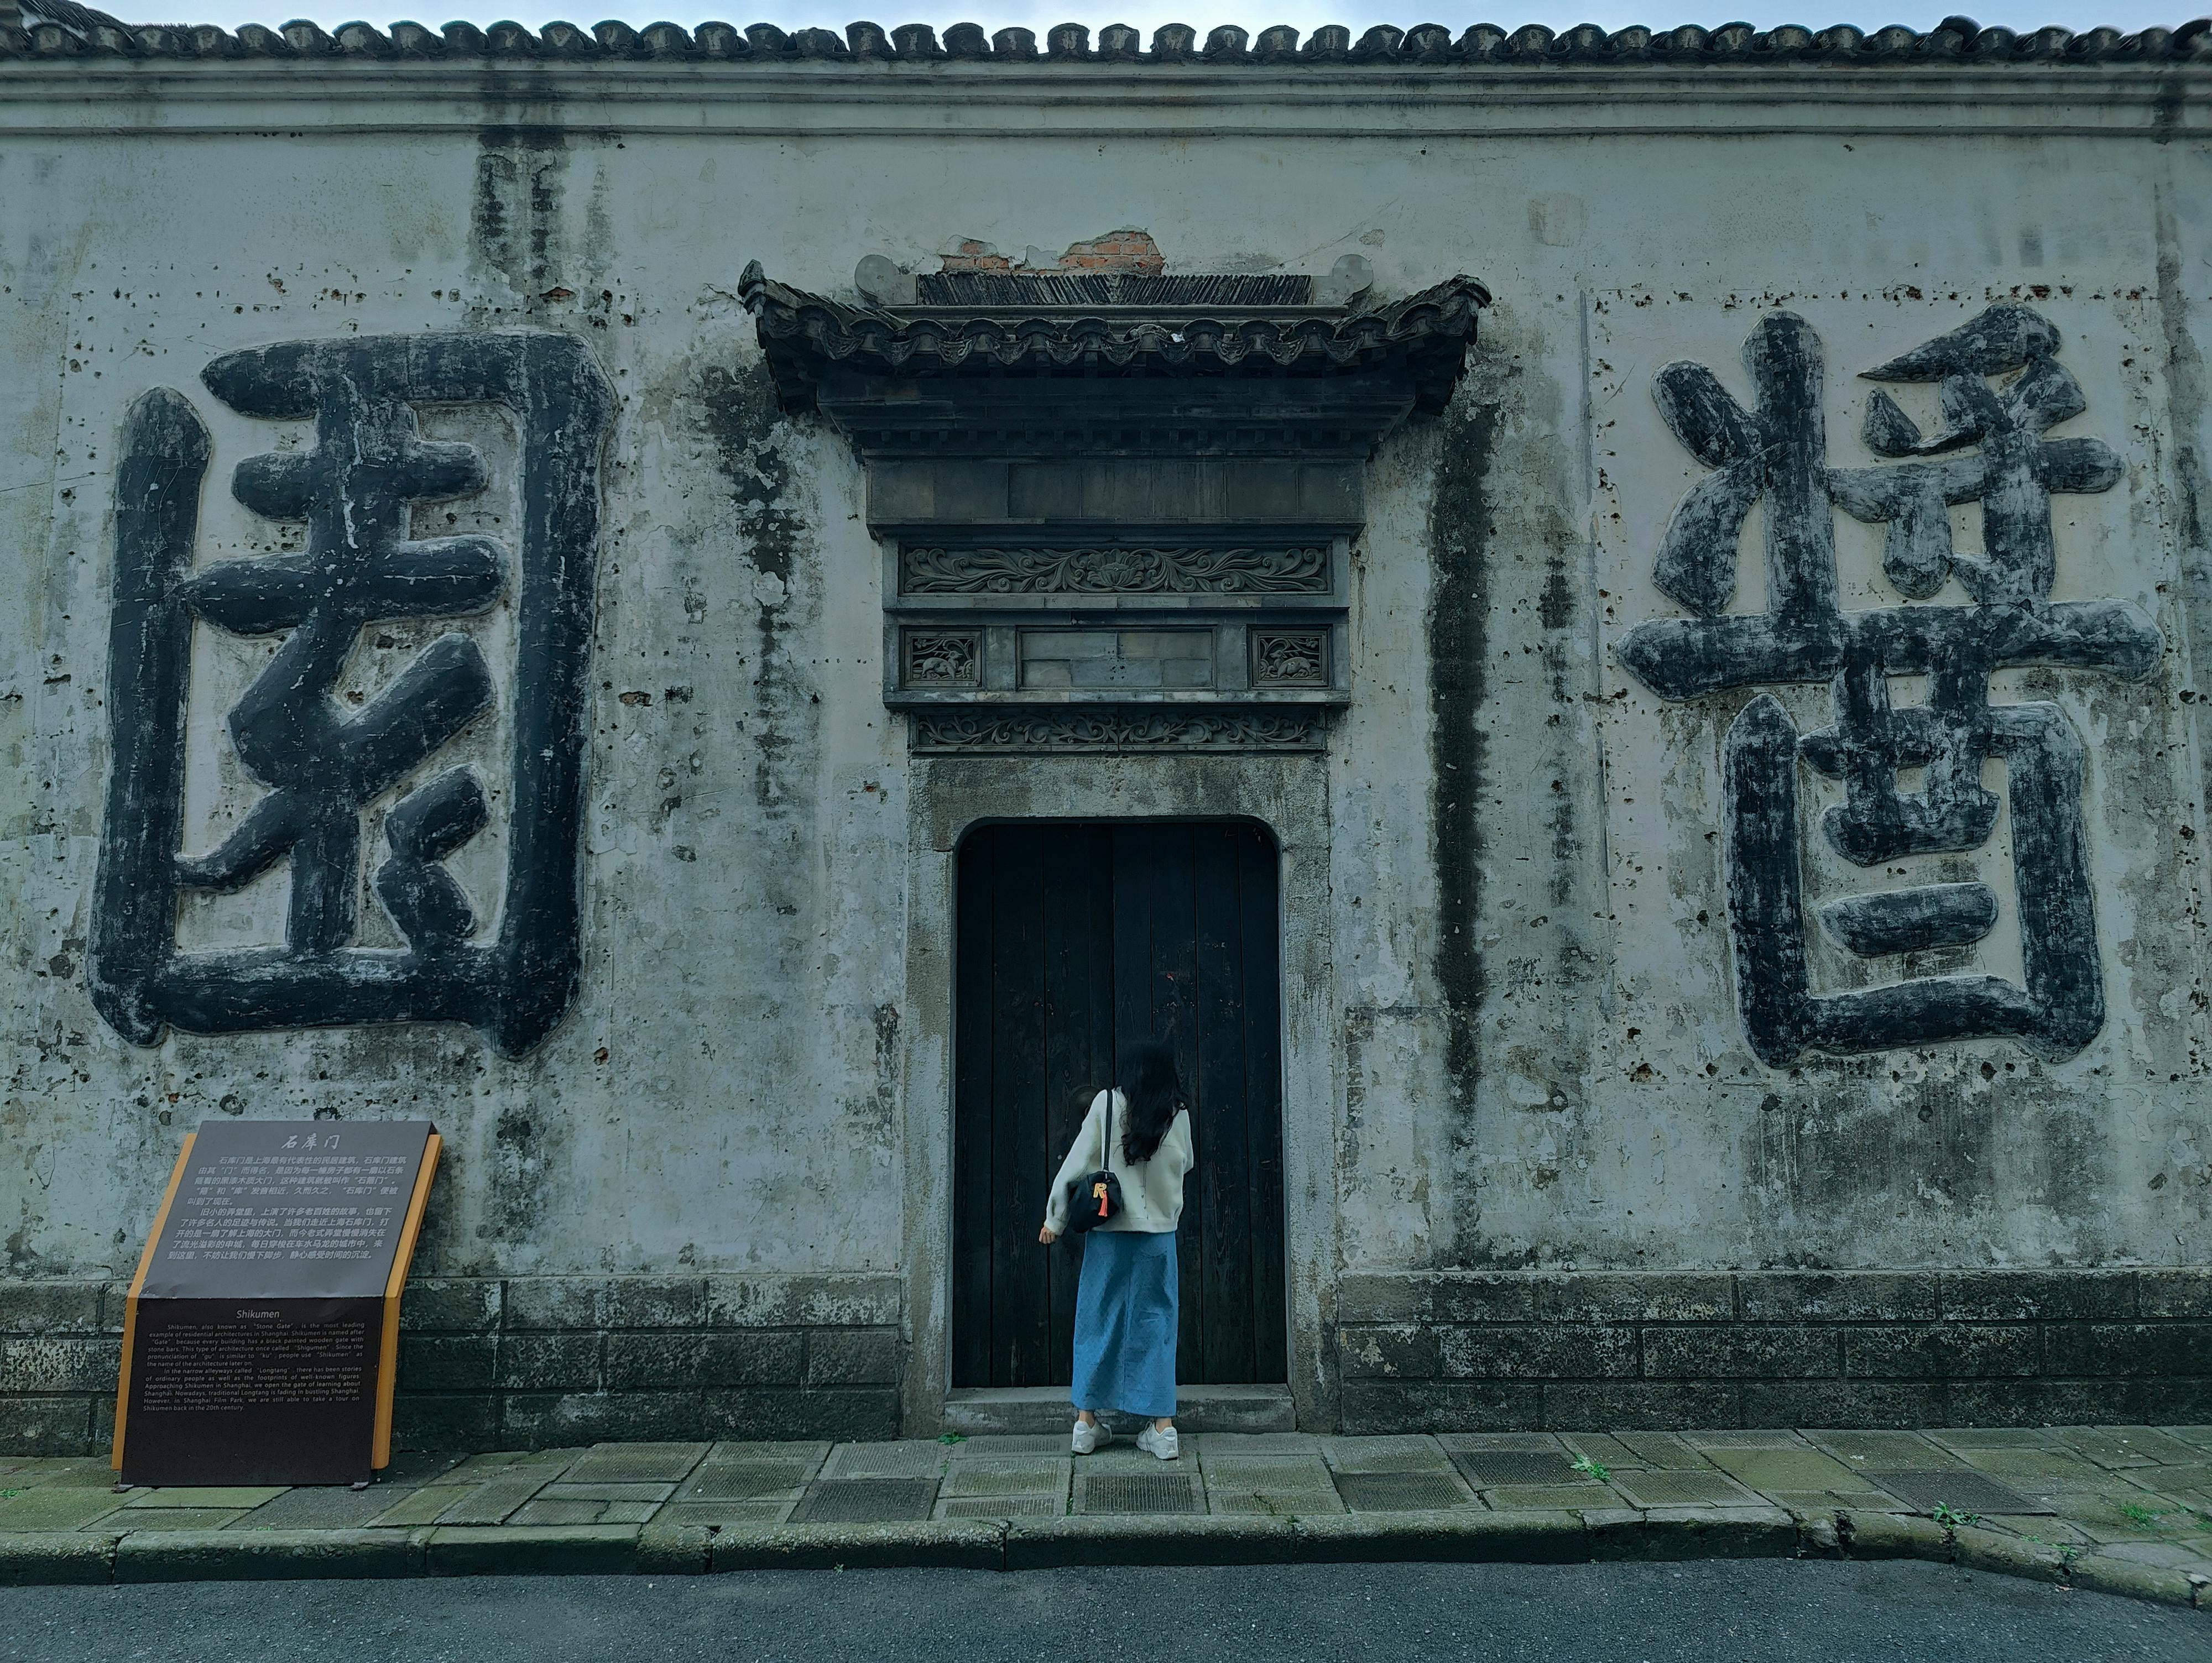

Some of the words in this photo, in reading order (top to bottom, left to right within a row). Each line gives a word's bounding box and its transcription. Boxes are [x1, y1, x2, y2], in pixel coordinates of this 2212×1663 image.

[281, 1133, 341, 1151] 石库门
[237, 1310, 280, 1319] Shikumen
